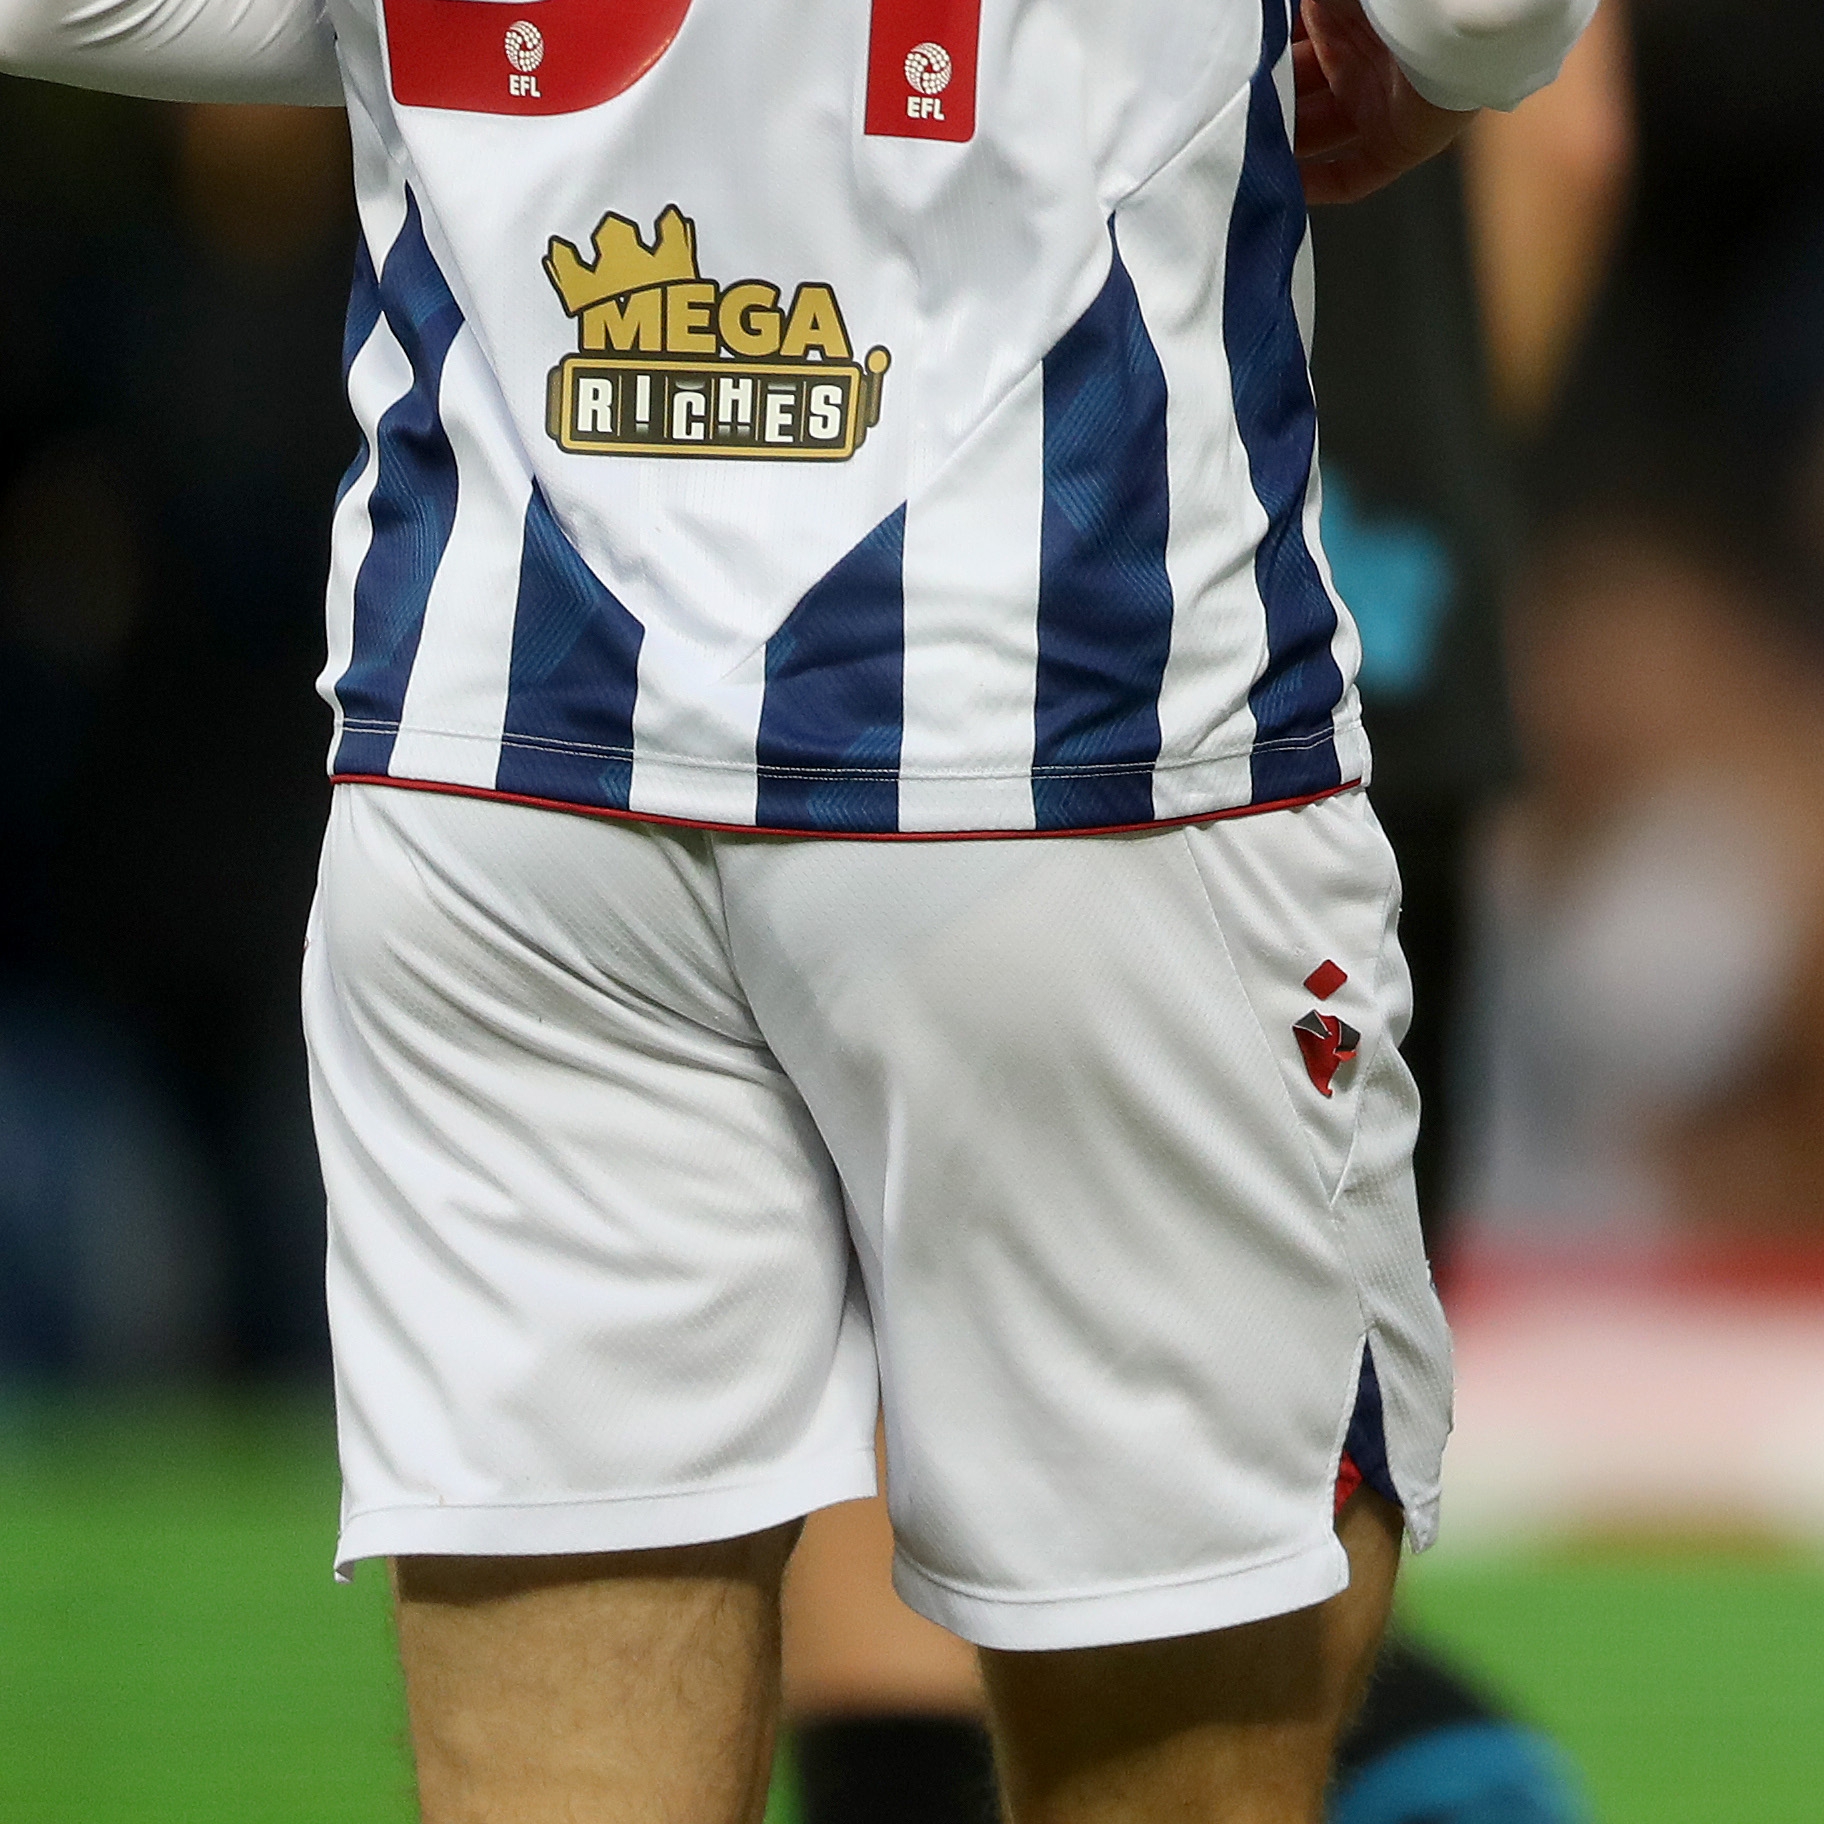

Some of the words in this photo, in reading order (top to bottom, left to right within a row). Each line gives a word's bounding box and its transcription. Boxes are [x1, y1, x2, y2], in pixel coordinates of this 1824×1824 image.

[508, 73, 541, 99] EFL
[906, 96, 946, 122] EFL
[581, 282, 852, 360] MEGA
[576, 373, 845, 445] RICHES
